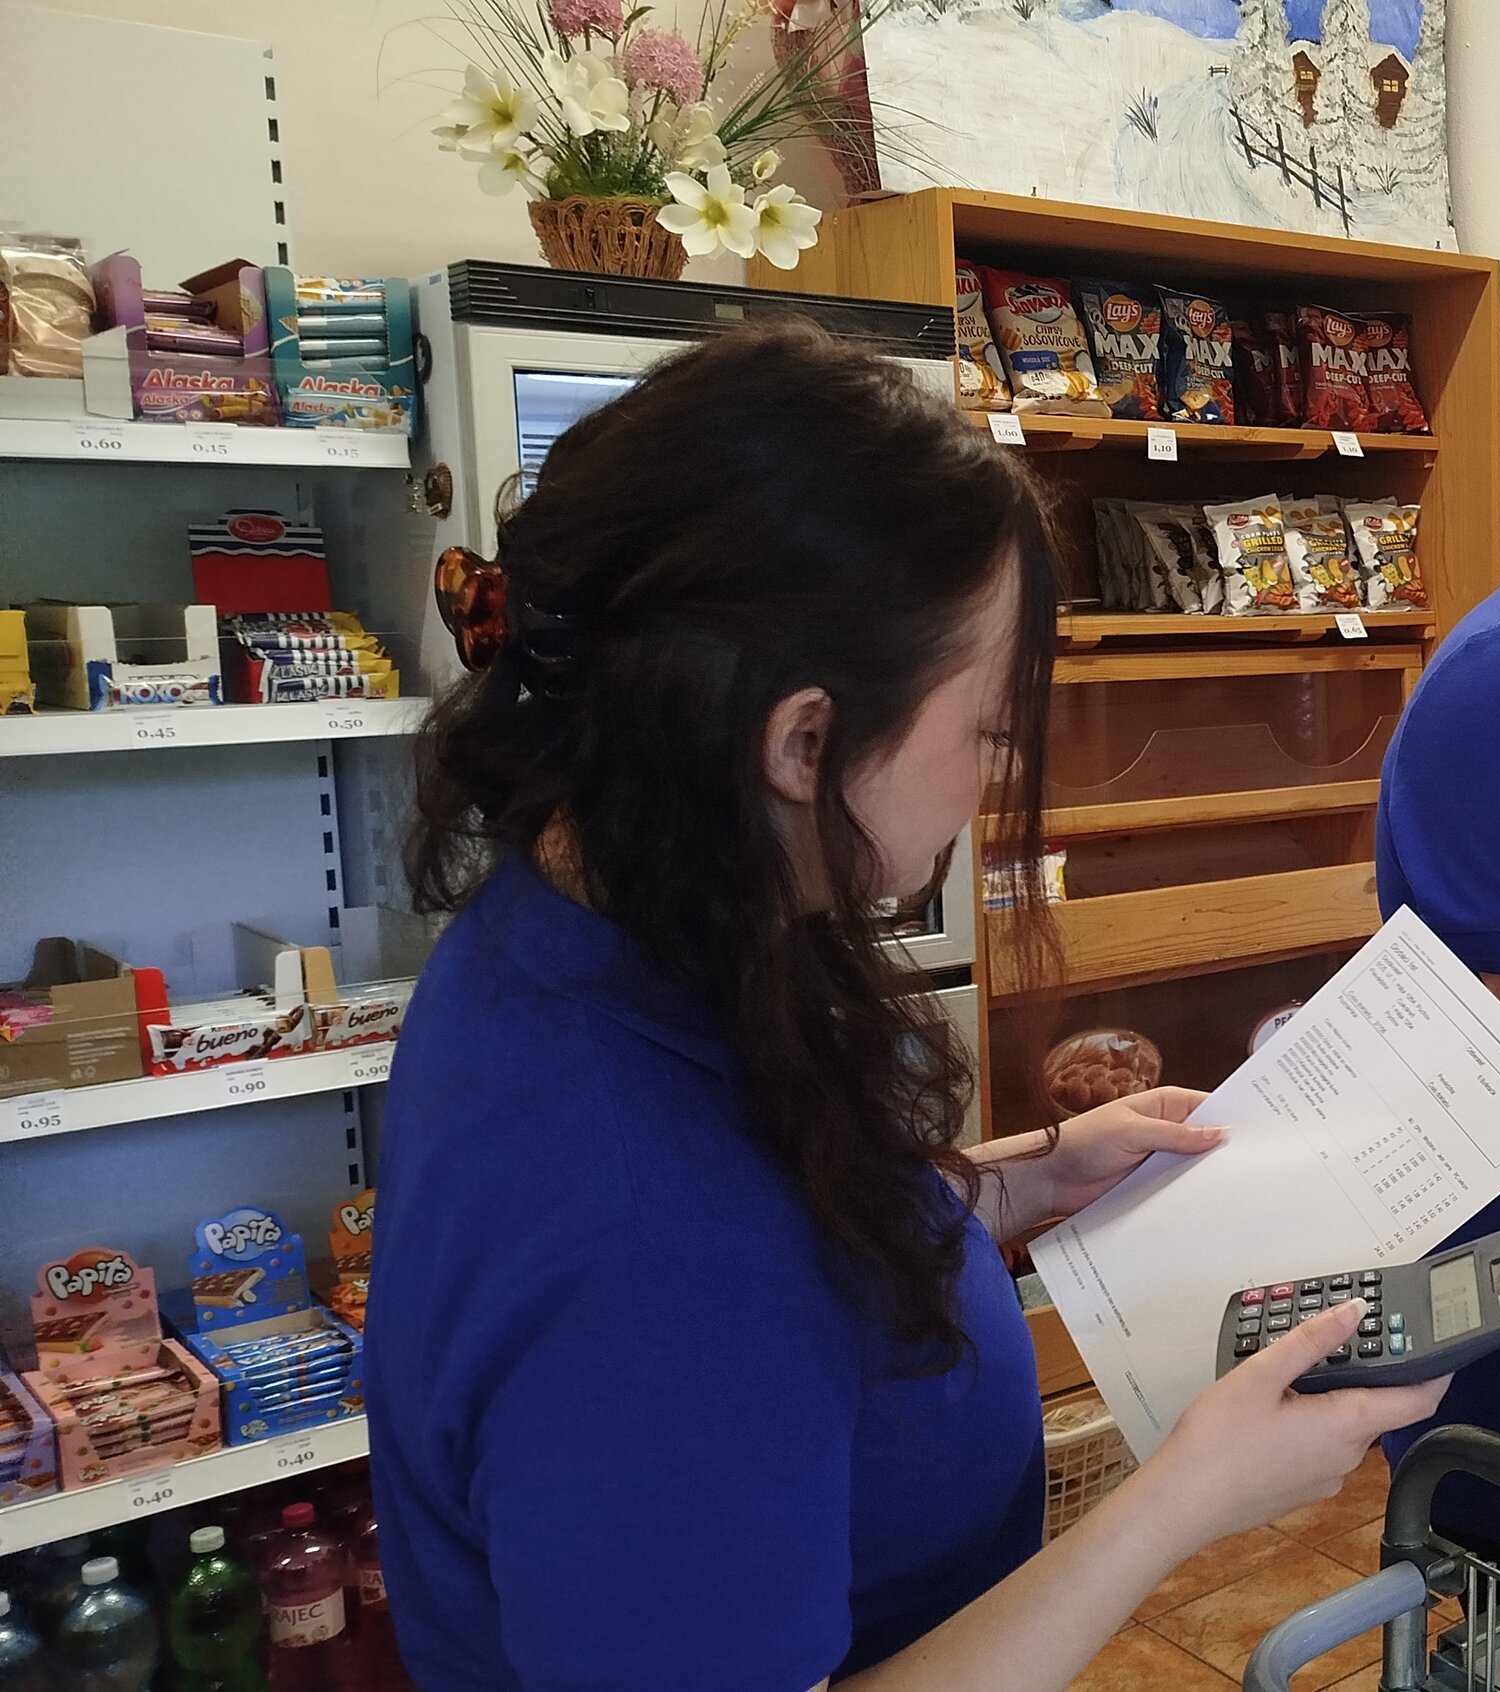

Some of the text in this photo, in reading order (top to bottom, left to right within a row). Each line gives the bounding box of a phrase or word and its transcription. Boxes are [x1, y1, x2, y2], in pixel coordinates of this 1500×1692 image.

[1106, 302, 1139, 322] Lay's
[1326, 317, 1352, 337] Lay's
[1366, 324, 1390, 338] ay's
[1094, 331, 1160, 360] MAX
[1183, 334, 1233, 367] MAX
[1111, 361, 1154, 374] DEEP-CUT
[1311, 342, 1368, 377] MAX
[143, 368, 235, 389] Alaska
[141, 394, 189, 406] Alaska
[291, 401, 335, 414] Alaska
[1243, 536, 1283, 548] GRILLED
[348, 1006, 399, 1028] bueno
[196, 1028, 258, 1053] bueno
[341, 1206, 374, 1235] Pap
[204, 1216, 282, 1255] Papita
[47, 1256, 133, 1300] Papita
